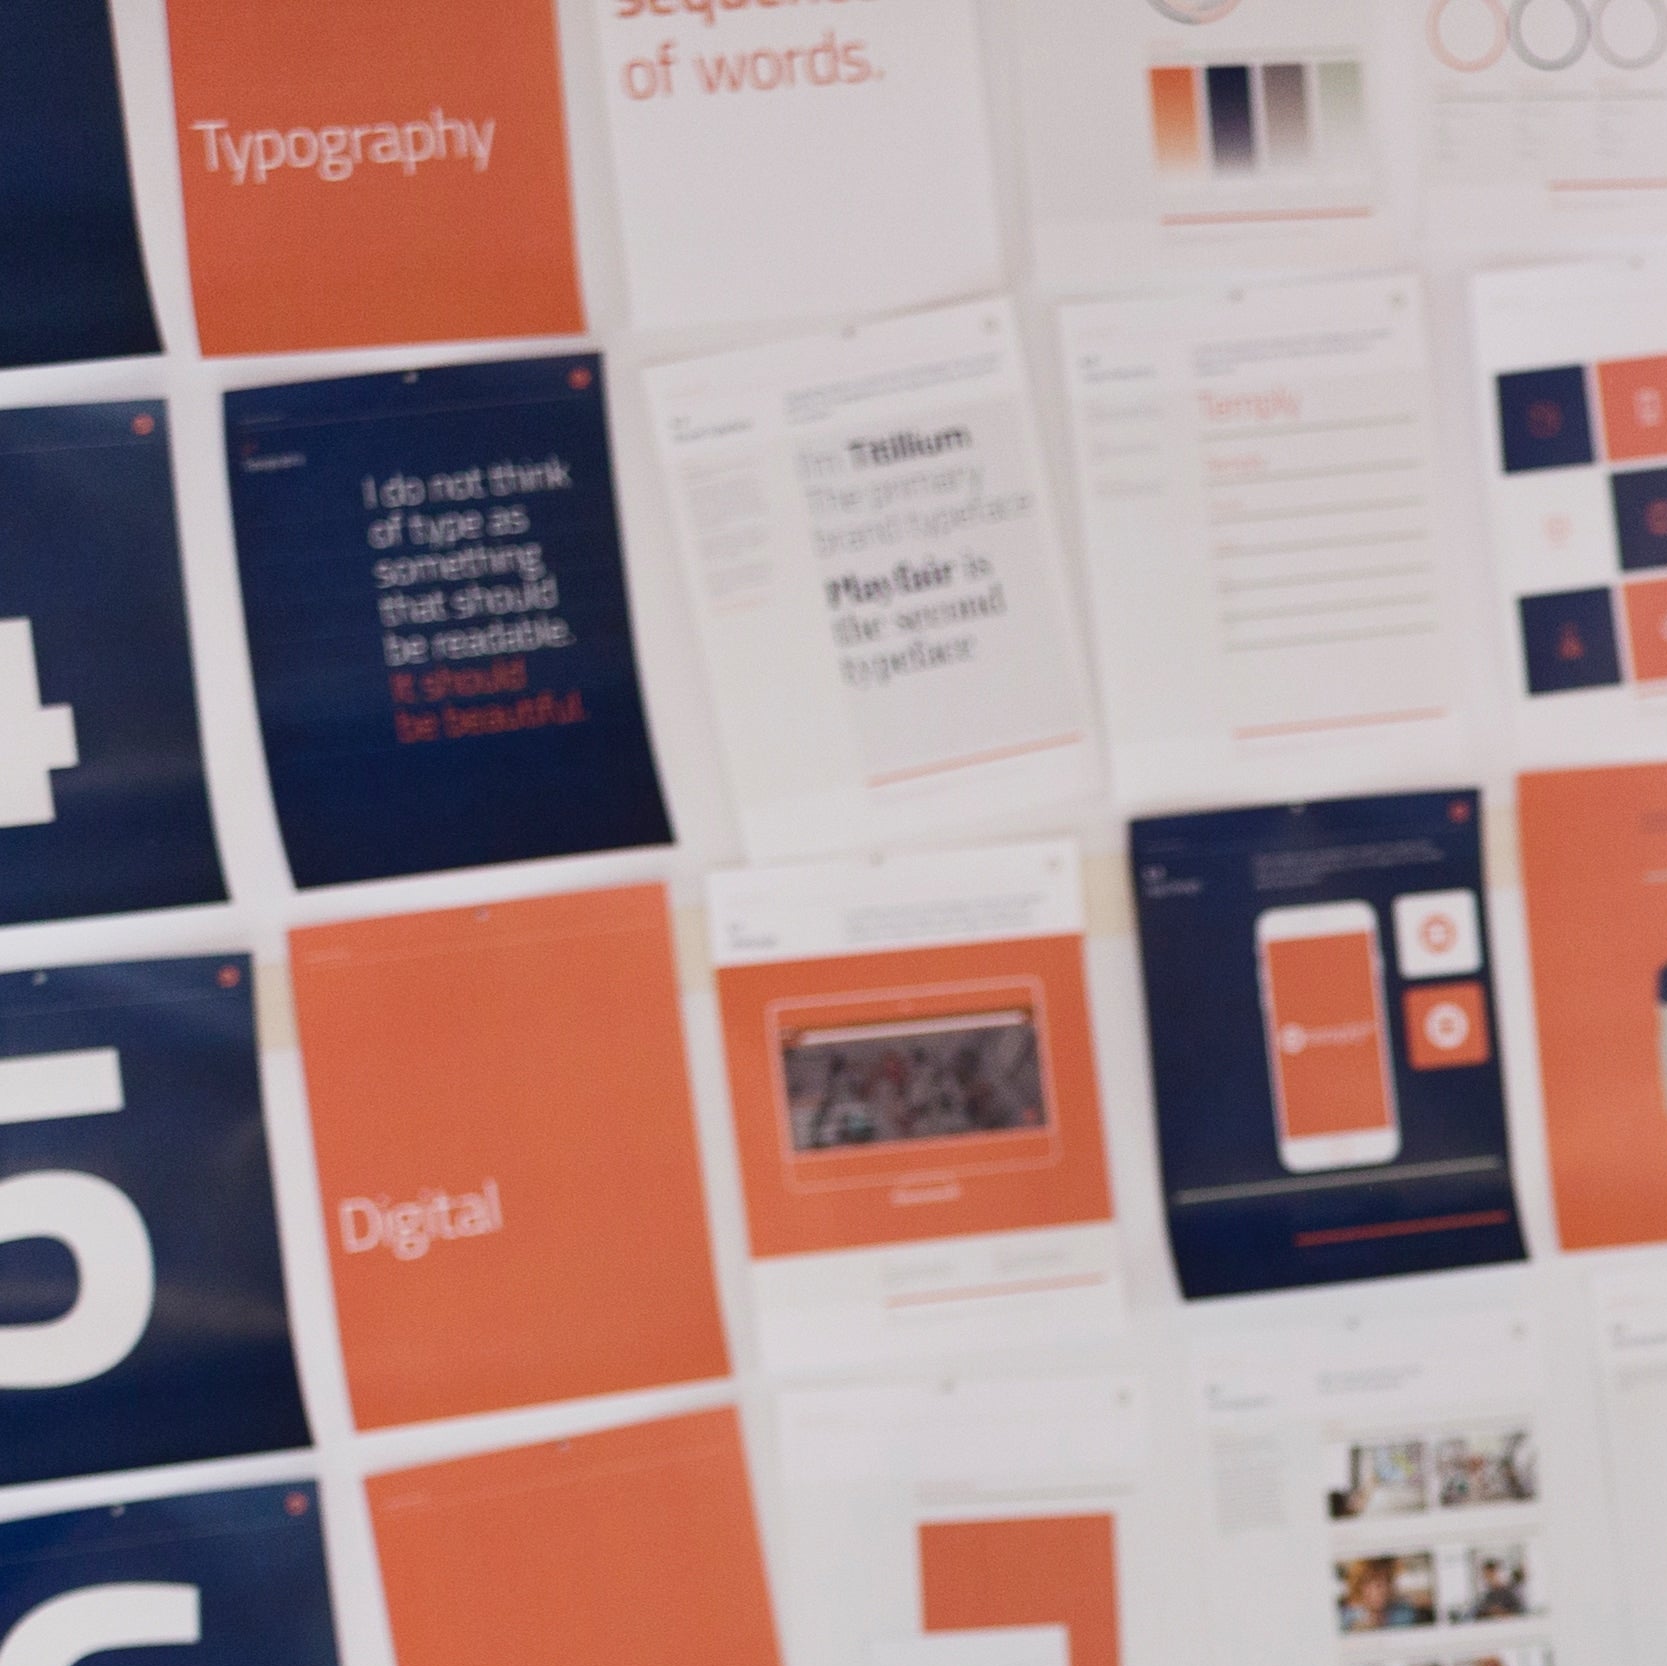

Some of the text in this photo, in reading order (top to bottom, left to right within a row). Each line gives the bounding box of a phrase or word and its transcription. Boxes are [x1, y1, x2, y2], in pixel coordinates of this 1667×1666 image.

[620, 29, 886, 101] of words.
[188, 105, 496, 186] Typography
[362, 453, 572, 510] I do not think
[368, 502, 530, 552] of type as
[371, 541, 547, 589] something
[825, 552, 994, 611] Playfair is
[378, 574, 559, 627] that should
[832, 580, 1008, 648] the second
[383, 615, 577, 667] be readable.
[421, 657, 527, 697] should
[394, 705, 439, 744] be
[0, 1047, 155, 1389] 5
[338, 1175, 502, 1261] Digital
